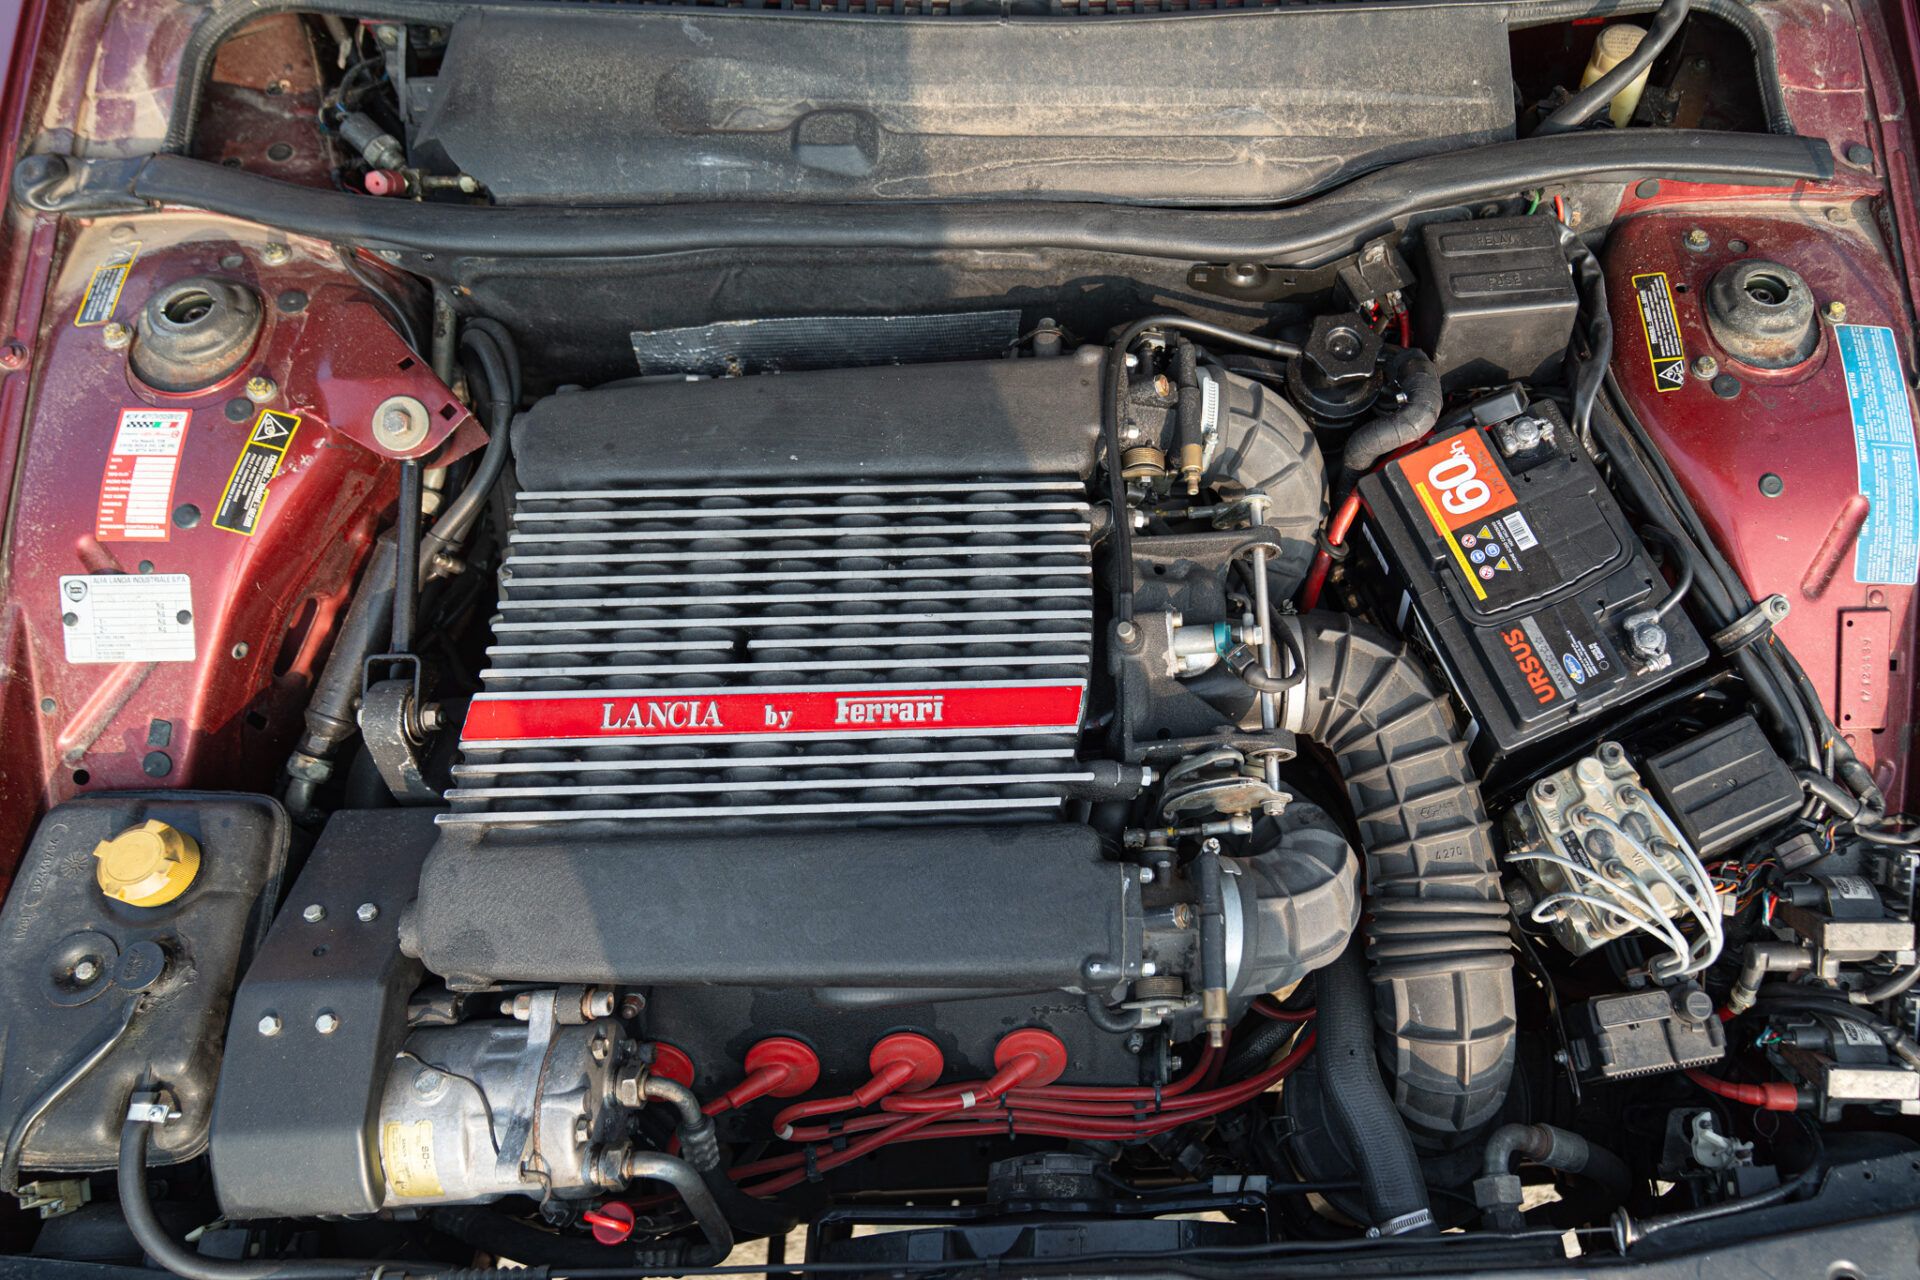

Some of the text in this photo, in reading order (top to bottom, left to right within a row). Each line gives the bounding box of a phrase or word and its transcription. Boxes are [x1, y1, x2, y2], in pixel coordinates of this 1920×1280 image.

[1856, 425, 1869, 463] IMPORTANT
[1504, 628, 1557, 705] URSUS
[601, 696, 945, 729] LANCIA by Ferrari
[1434, 846, 1463, 861] 4270
